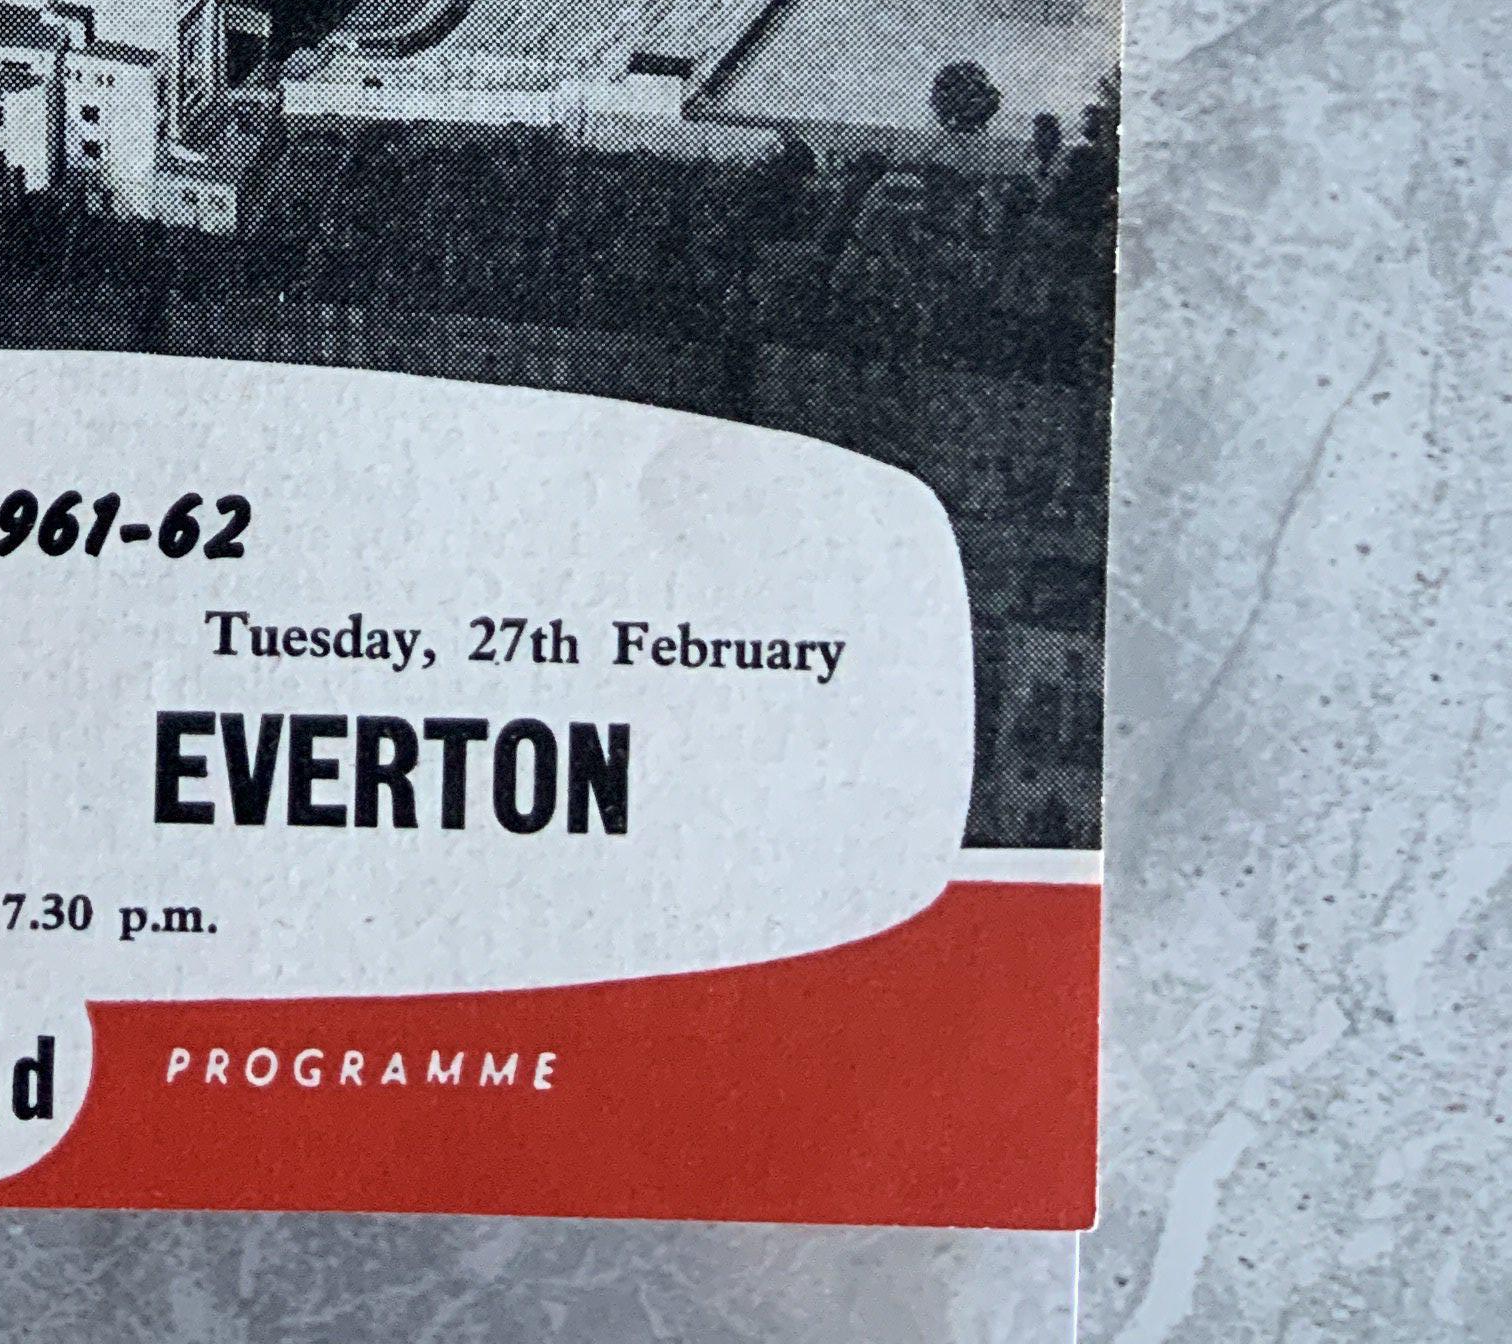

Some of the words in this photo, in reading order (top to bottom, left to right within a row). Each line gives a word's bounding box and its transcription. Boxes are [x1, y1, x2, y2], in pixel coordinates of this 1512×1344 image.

[204, 610, 436, 673] Tuesday,
[468, 616, 580, 664] 27th
[612, 621, 846, 685] February
[154, 710, 631, 835] EVERTON
[2, 893, 94, 931] 7.30
[119, 906, 217, 941] p.m.
[166, 1047, 557, 1090] PROGRAMME
